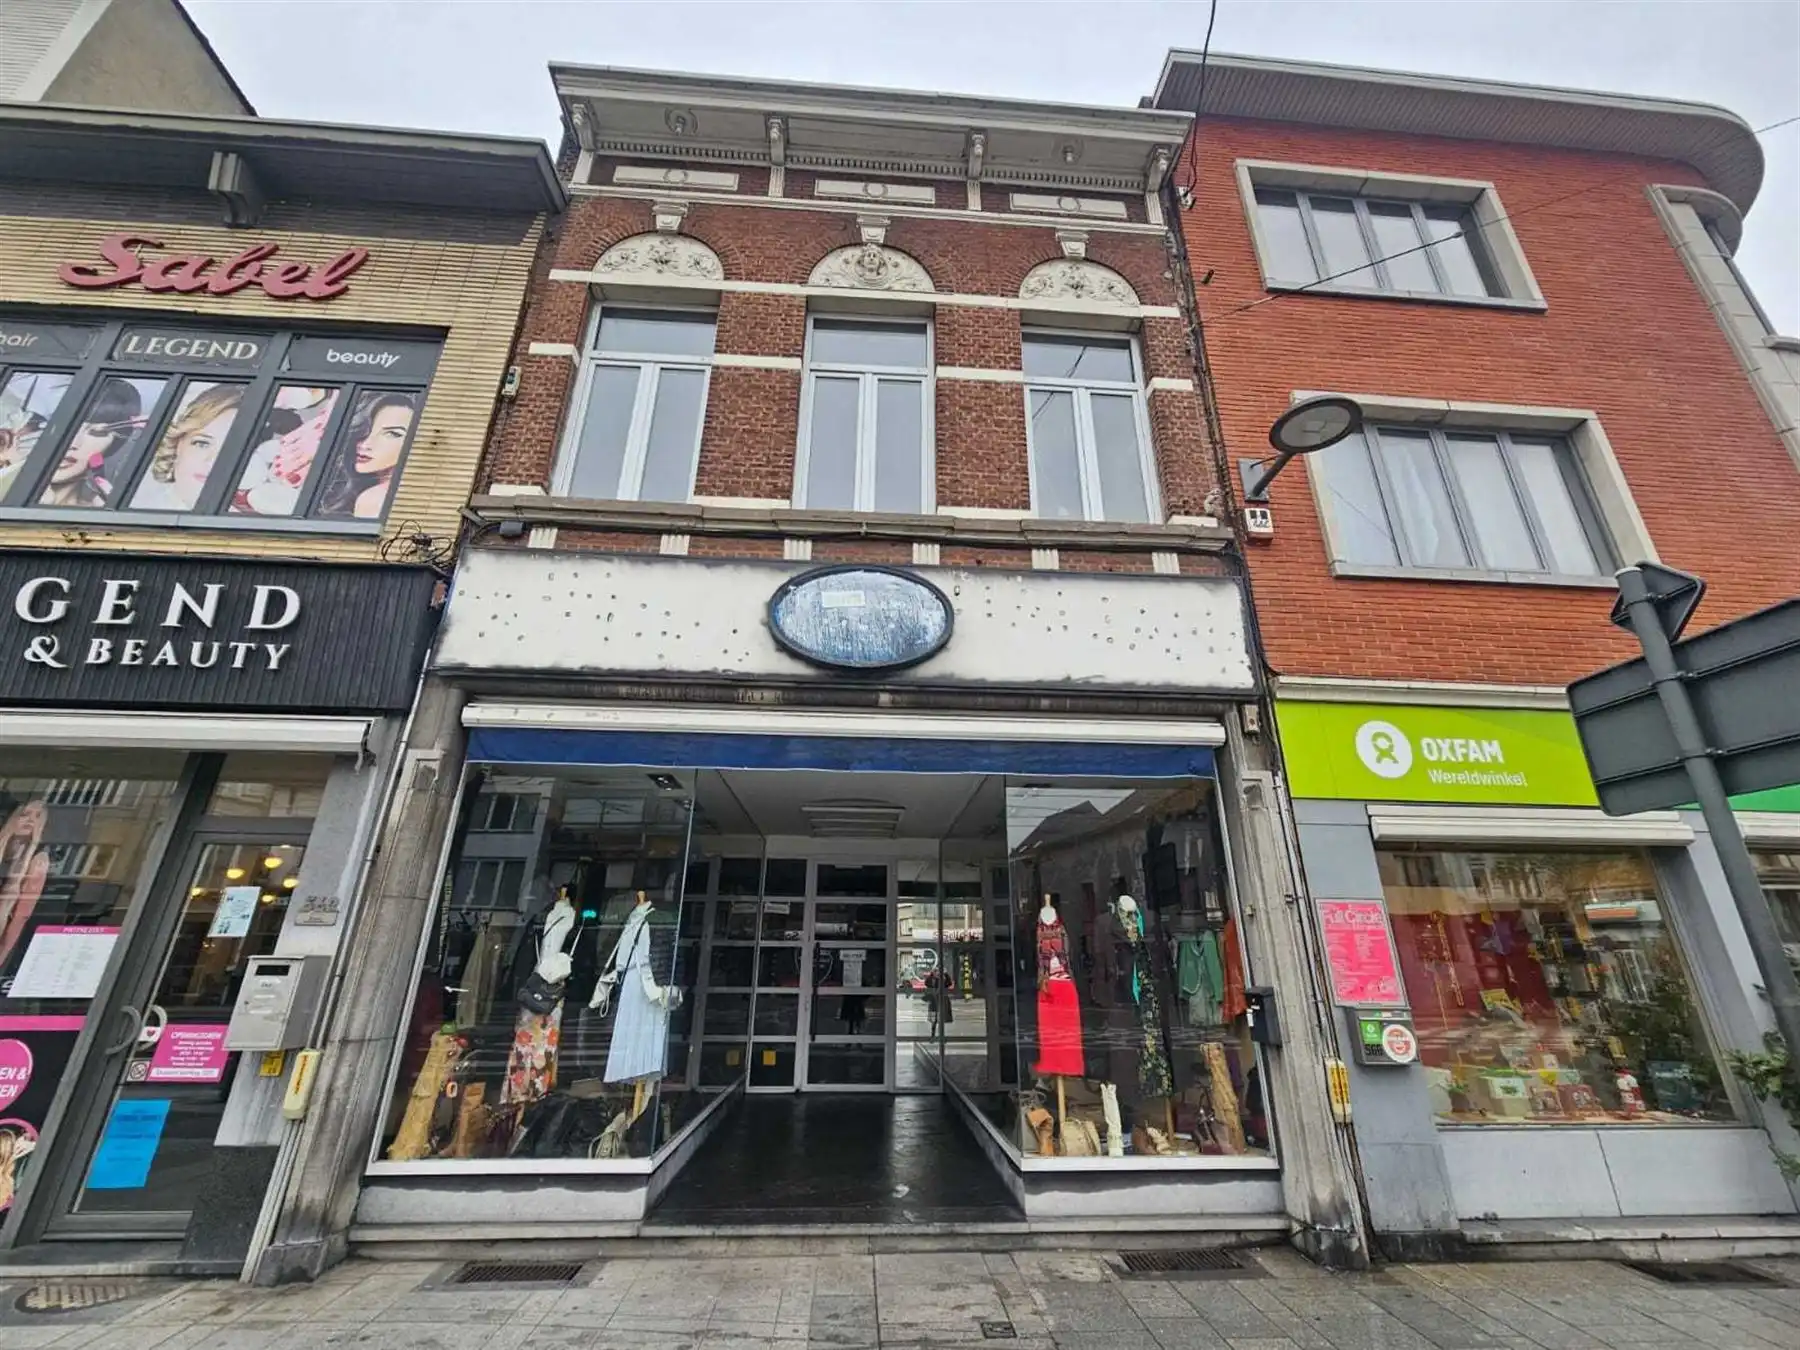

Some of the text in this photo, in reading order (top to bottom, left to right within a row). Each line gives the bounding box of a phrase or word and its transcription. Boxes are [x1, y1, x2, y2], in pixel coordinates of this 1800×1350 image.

[58, 232, 370, 299] Sabel
[125, 334, 259, 361] LEGEND
[326, 348, 401, 369] beauty
[14, 576, 301, 629] GEND
[23, 634, 291, 670] & BEAUTY
[1420, 737, 1505, 764] OXFAM
[1427, 769, 1528, 787] Wereldwinkel
